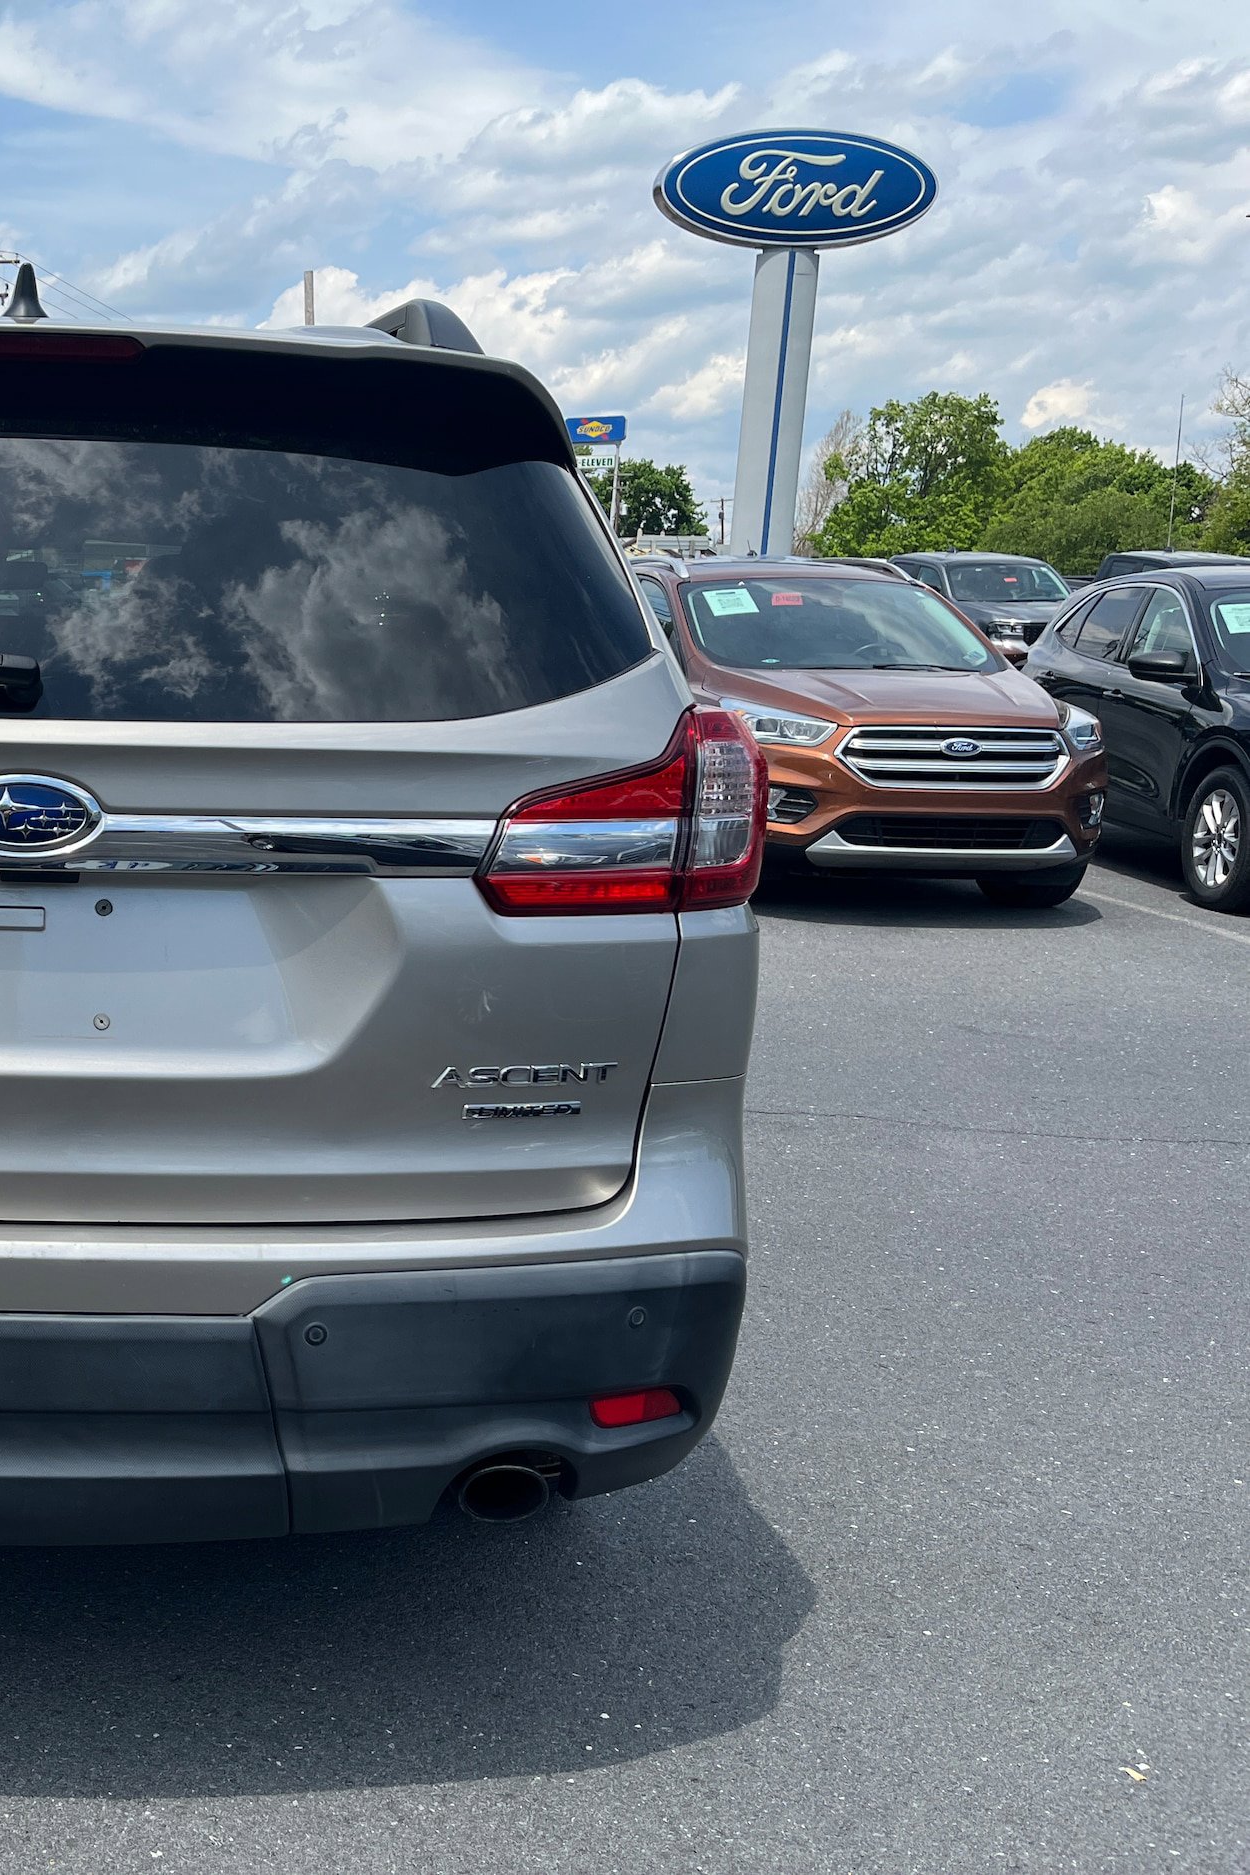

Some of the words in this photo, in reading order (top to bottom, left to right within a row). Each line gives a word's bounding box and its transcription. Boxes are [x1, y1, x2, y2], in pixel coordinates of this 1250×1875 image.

[720, 149, 885, 217] Ford
[579, 425, 610, 433] SUNOCO
[578, 458, 613, 467] -ELEVEN
[951, 742, 974, 751] Ford
[430, 1062, 619, 1089] ASCENT
[470, 1103, 573, 1119] LIMITED
